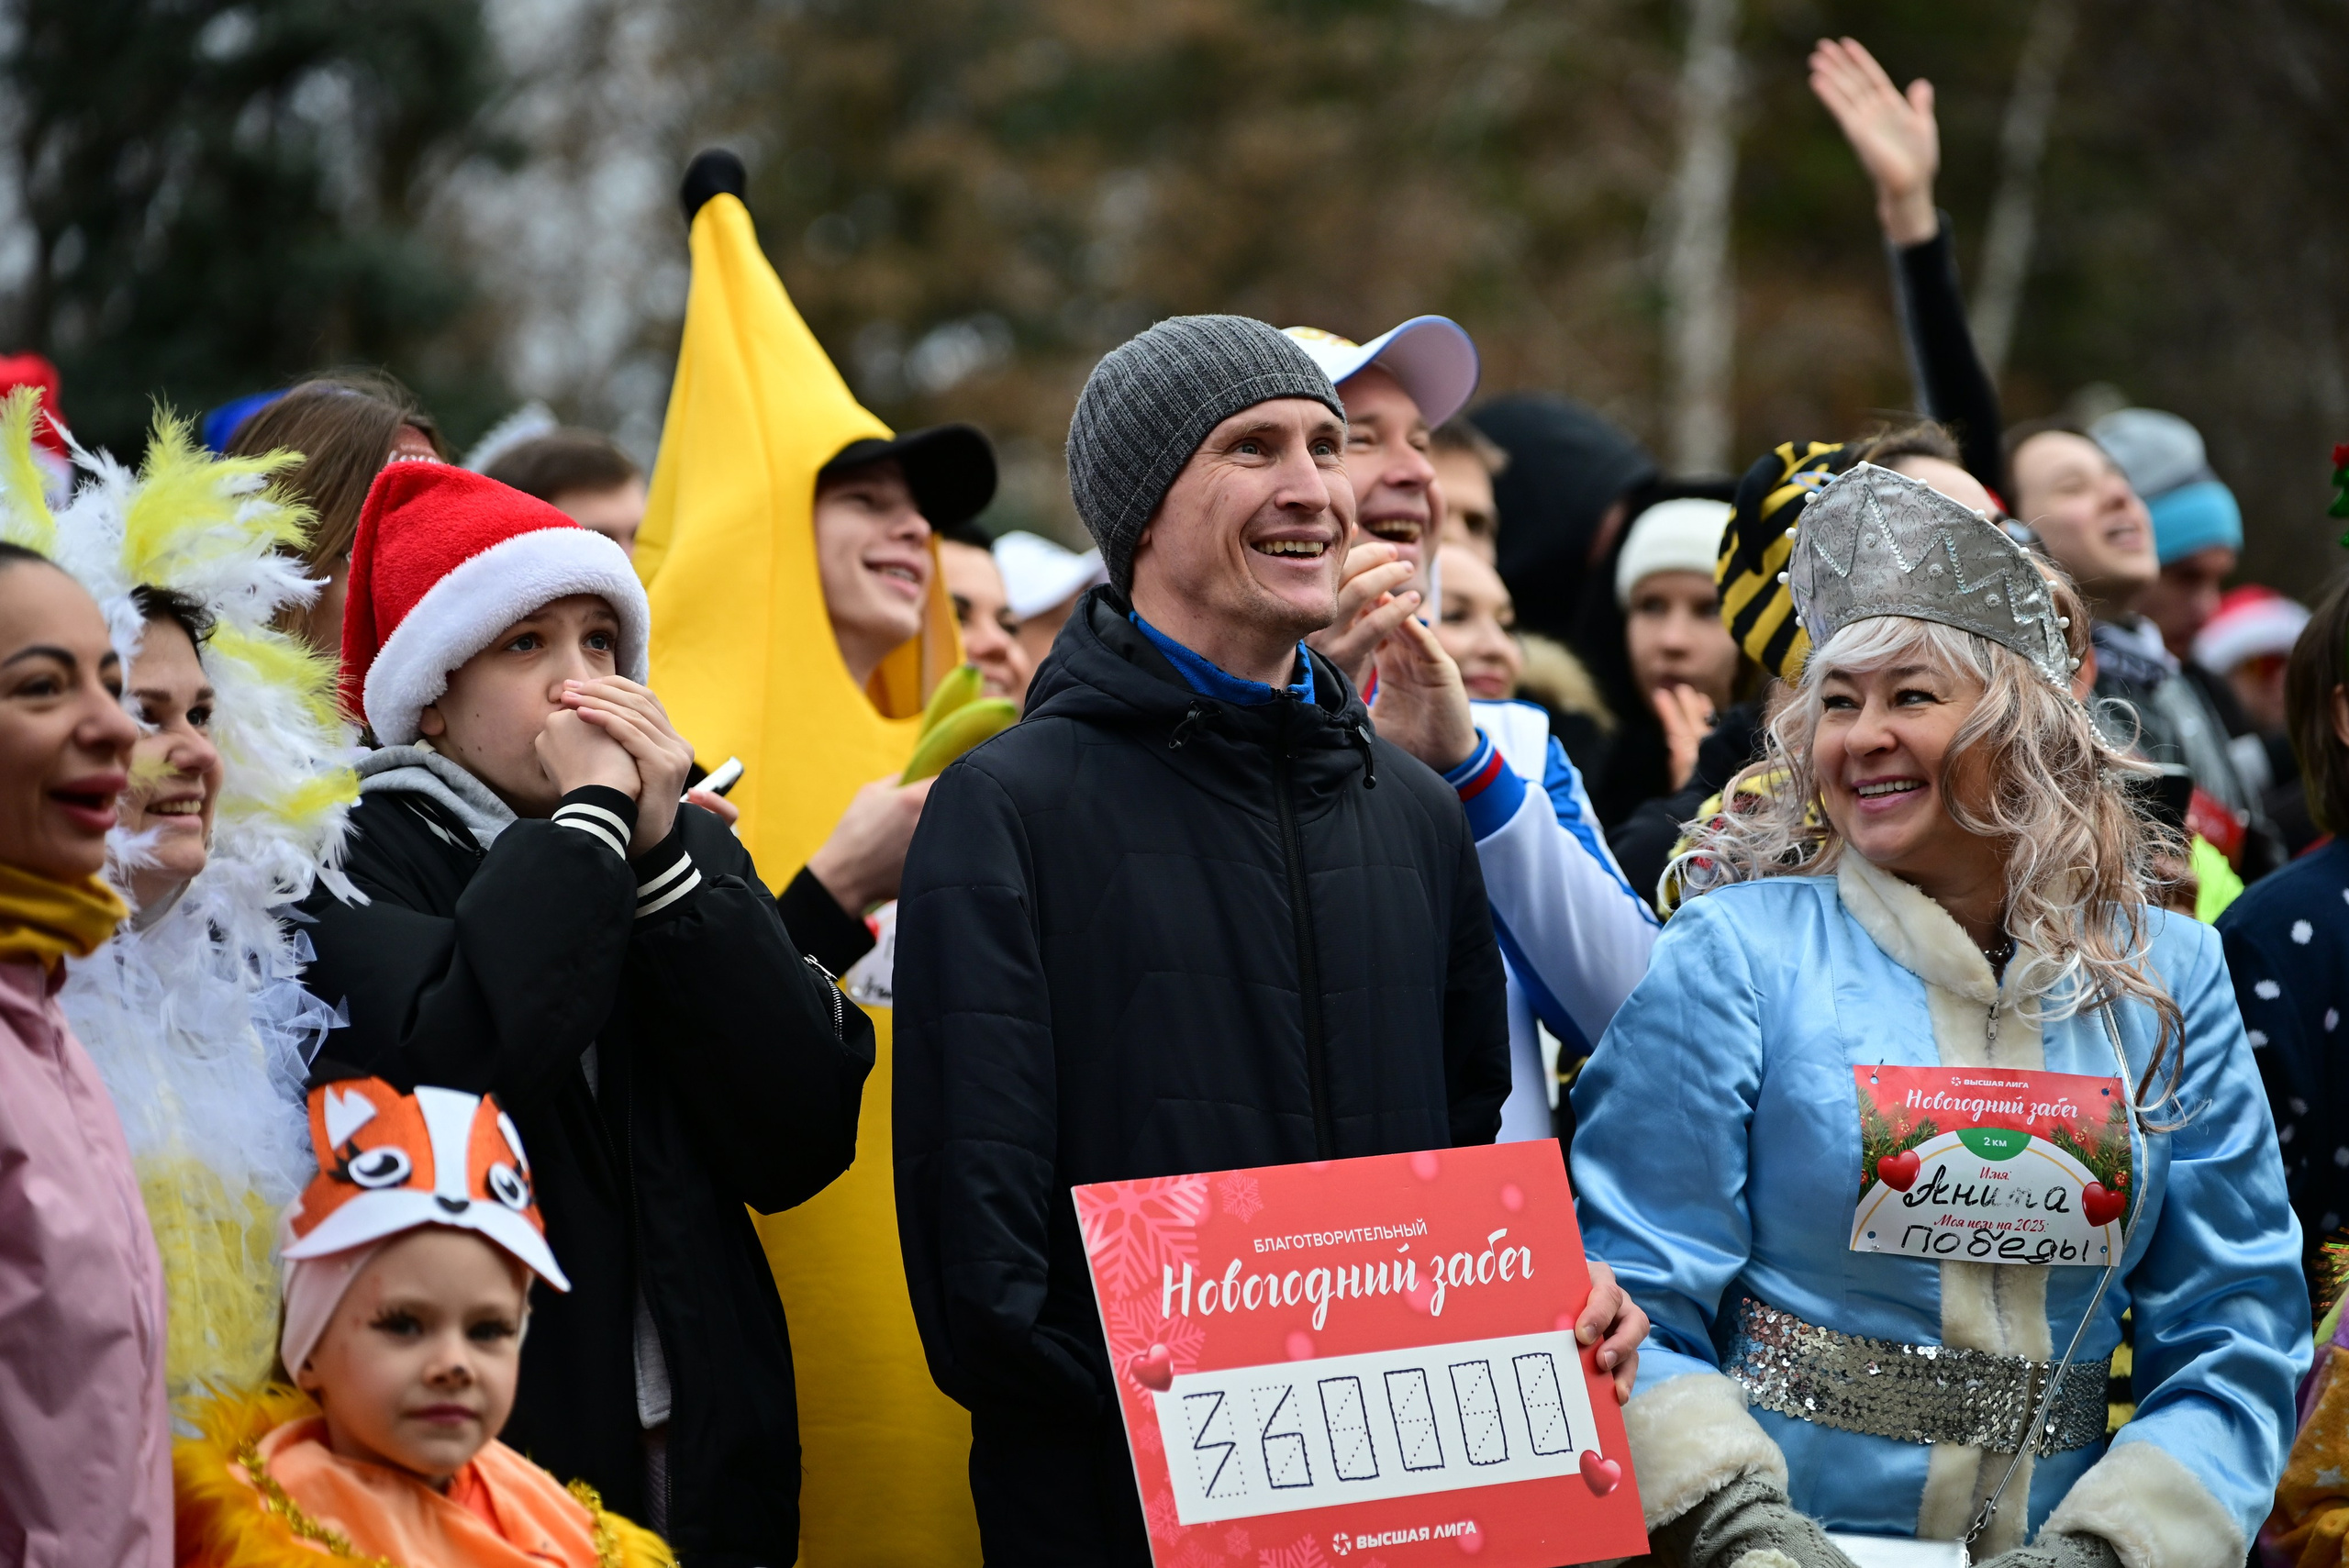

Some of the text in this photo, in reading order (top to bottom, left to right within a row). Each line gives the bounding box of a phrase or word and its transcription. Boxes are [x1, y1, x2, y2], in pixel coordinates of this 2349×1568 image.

[1964, 1078, 2029, 1089] ВЫСШАЯ ЛИГА
[1906, 1088, 2078, 1126] Новогодний забег
[1983, 1137, 1991, 1146] 2
[1979, 1166, 2011, 1181] Имя:
[1253, 1218, 1428, 1253] БЛАГОТВОРИТЕЛЬНЫЙ
[1933, 1214, 1965, 1227] Моя
[1996, 1220, 2012, 1230] на
[1161, 1228, 1535, 1330] Новогодний забег
[1183, 1352, 1574, 1498] 360000
[1356, 1520, 1476, 1550] ВЫСШАЯ ЛИГА
